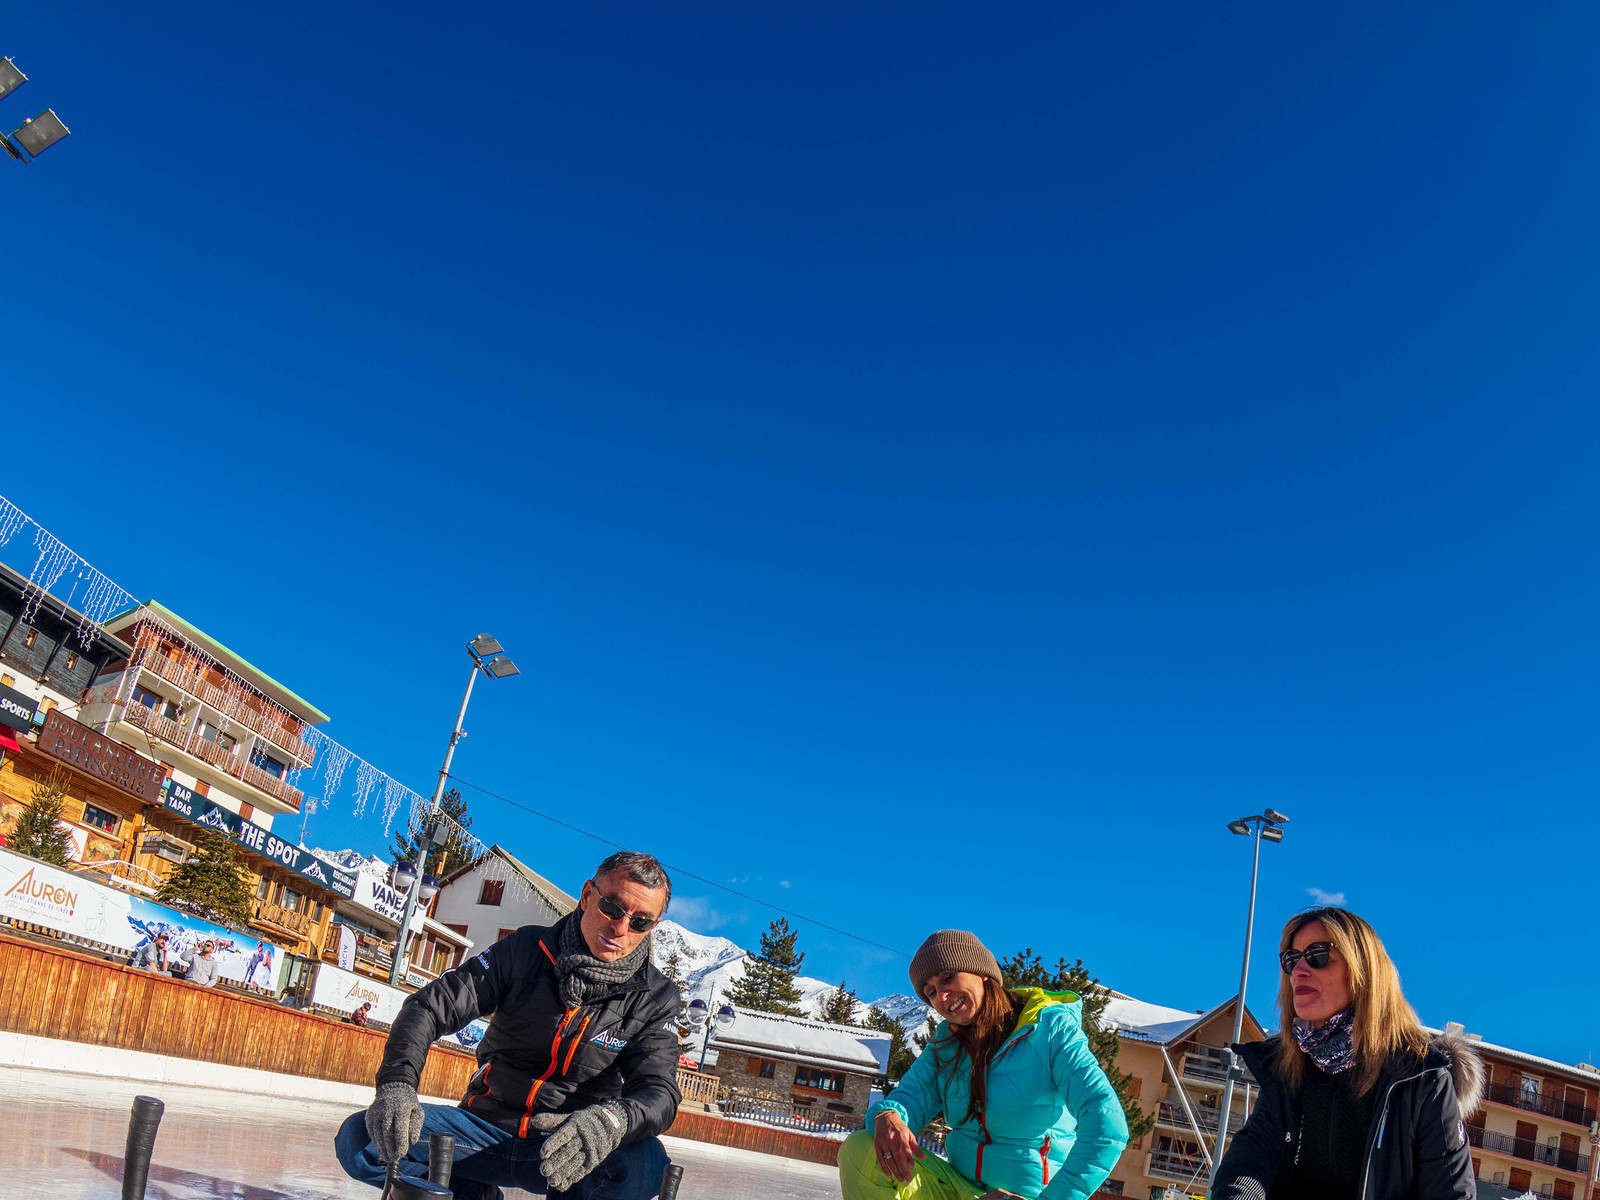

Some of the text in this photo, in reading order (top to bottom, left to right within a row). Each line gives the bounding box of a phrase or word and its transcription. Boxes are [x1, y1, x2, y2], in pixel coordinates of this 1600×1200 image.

[0, 698, 31, 720] SPORTS
[49, 713, 163, 784] BOULANGERIE
[53, 737, 147, 795] PATISSERIE
[168, 796, 192, 816] TAPAS
[174, 785, 192, 802] BAR
[240, 821, 300, 868] THE SPOT
[4, 866, 78, 909] AURON
[345, 980, 379, 1003] AURON
